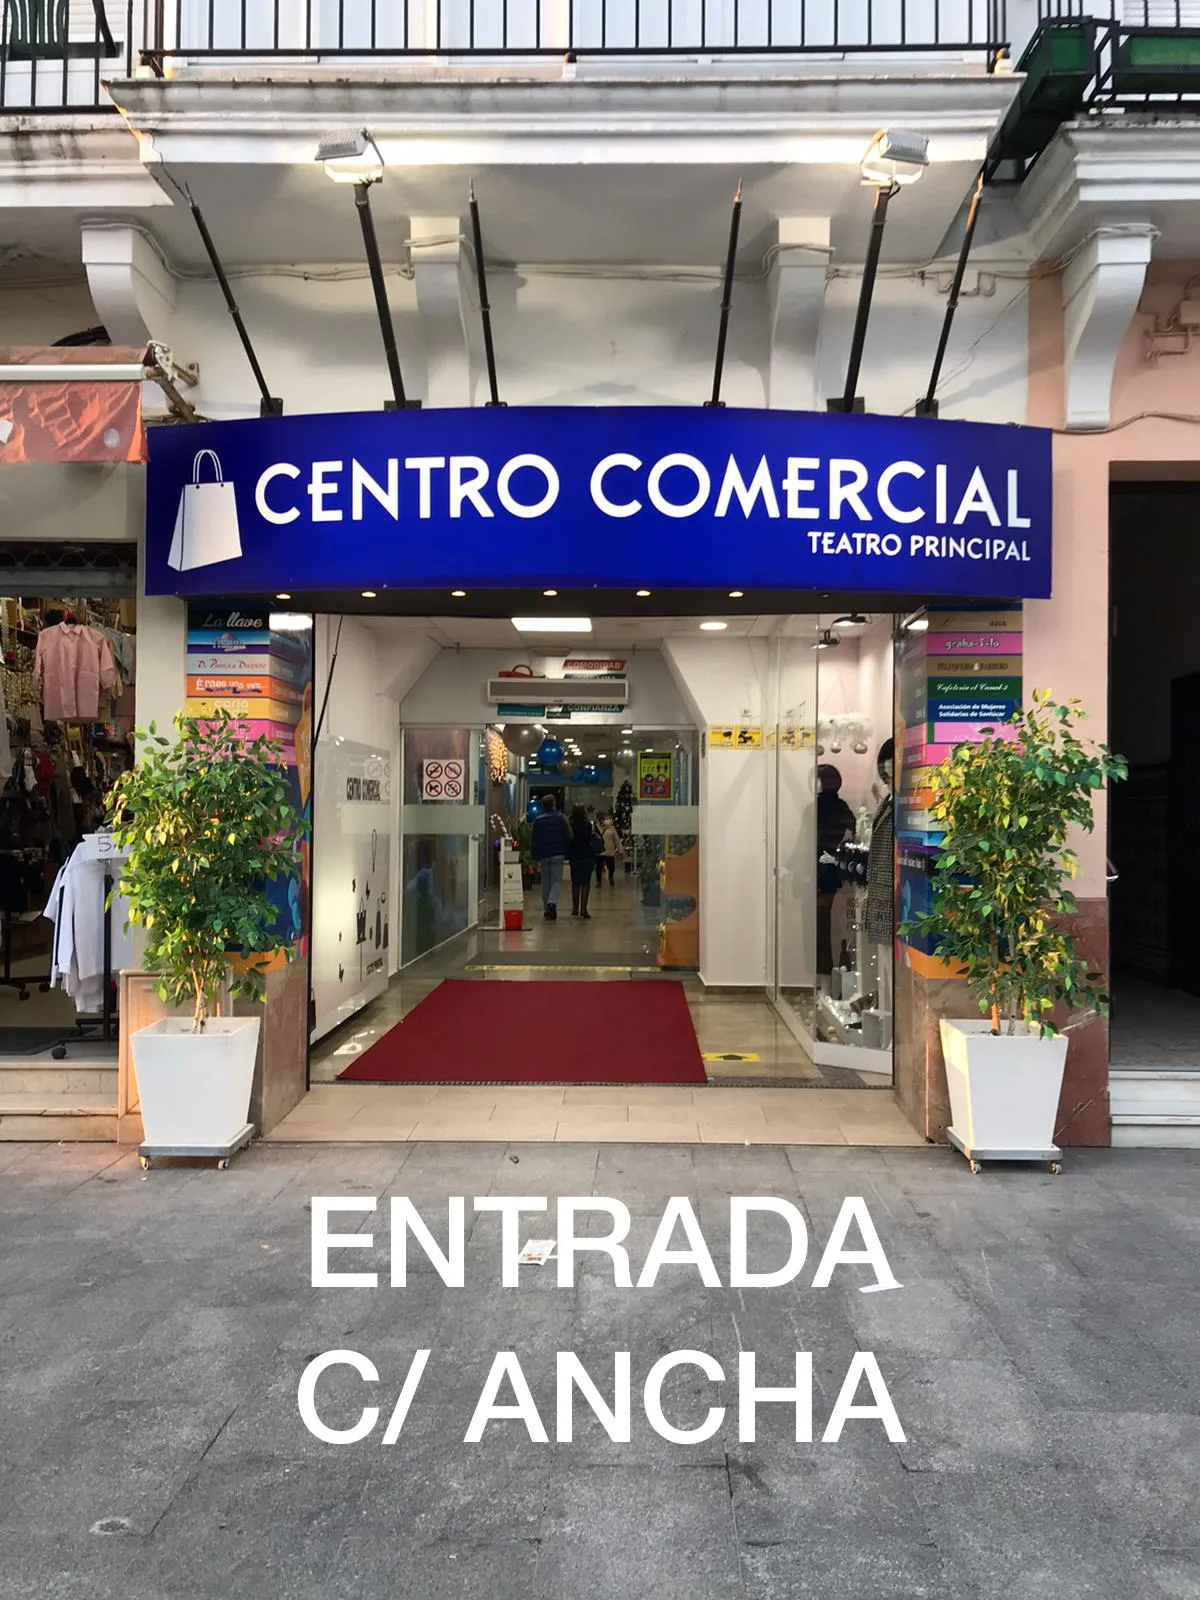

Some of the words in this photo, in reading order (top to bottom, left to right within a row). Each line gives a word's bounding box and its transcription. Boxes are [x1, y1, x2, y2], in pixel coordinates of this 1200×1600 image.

[254, 453, 561, 526] CENTRO
[589, 452, 1031, 529] COMERCIAL
[807, 531, 903, 557] TEATRO
[909, 534, 1032, 563] PRINCIPAL
[225, 610, 264, 629] llave
